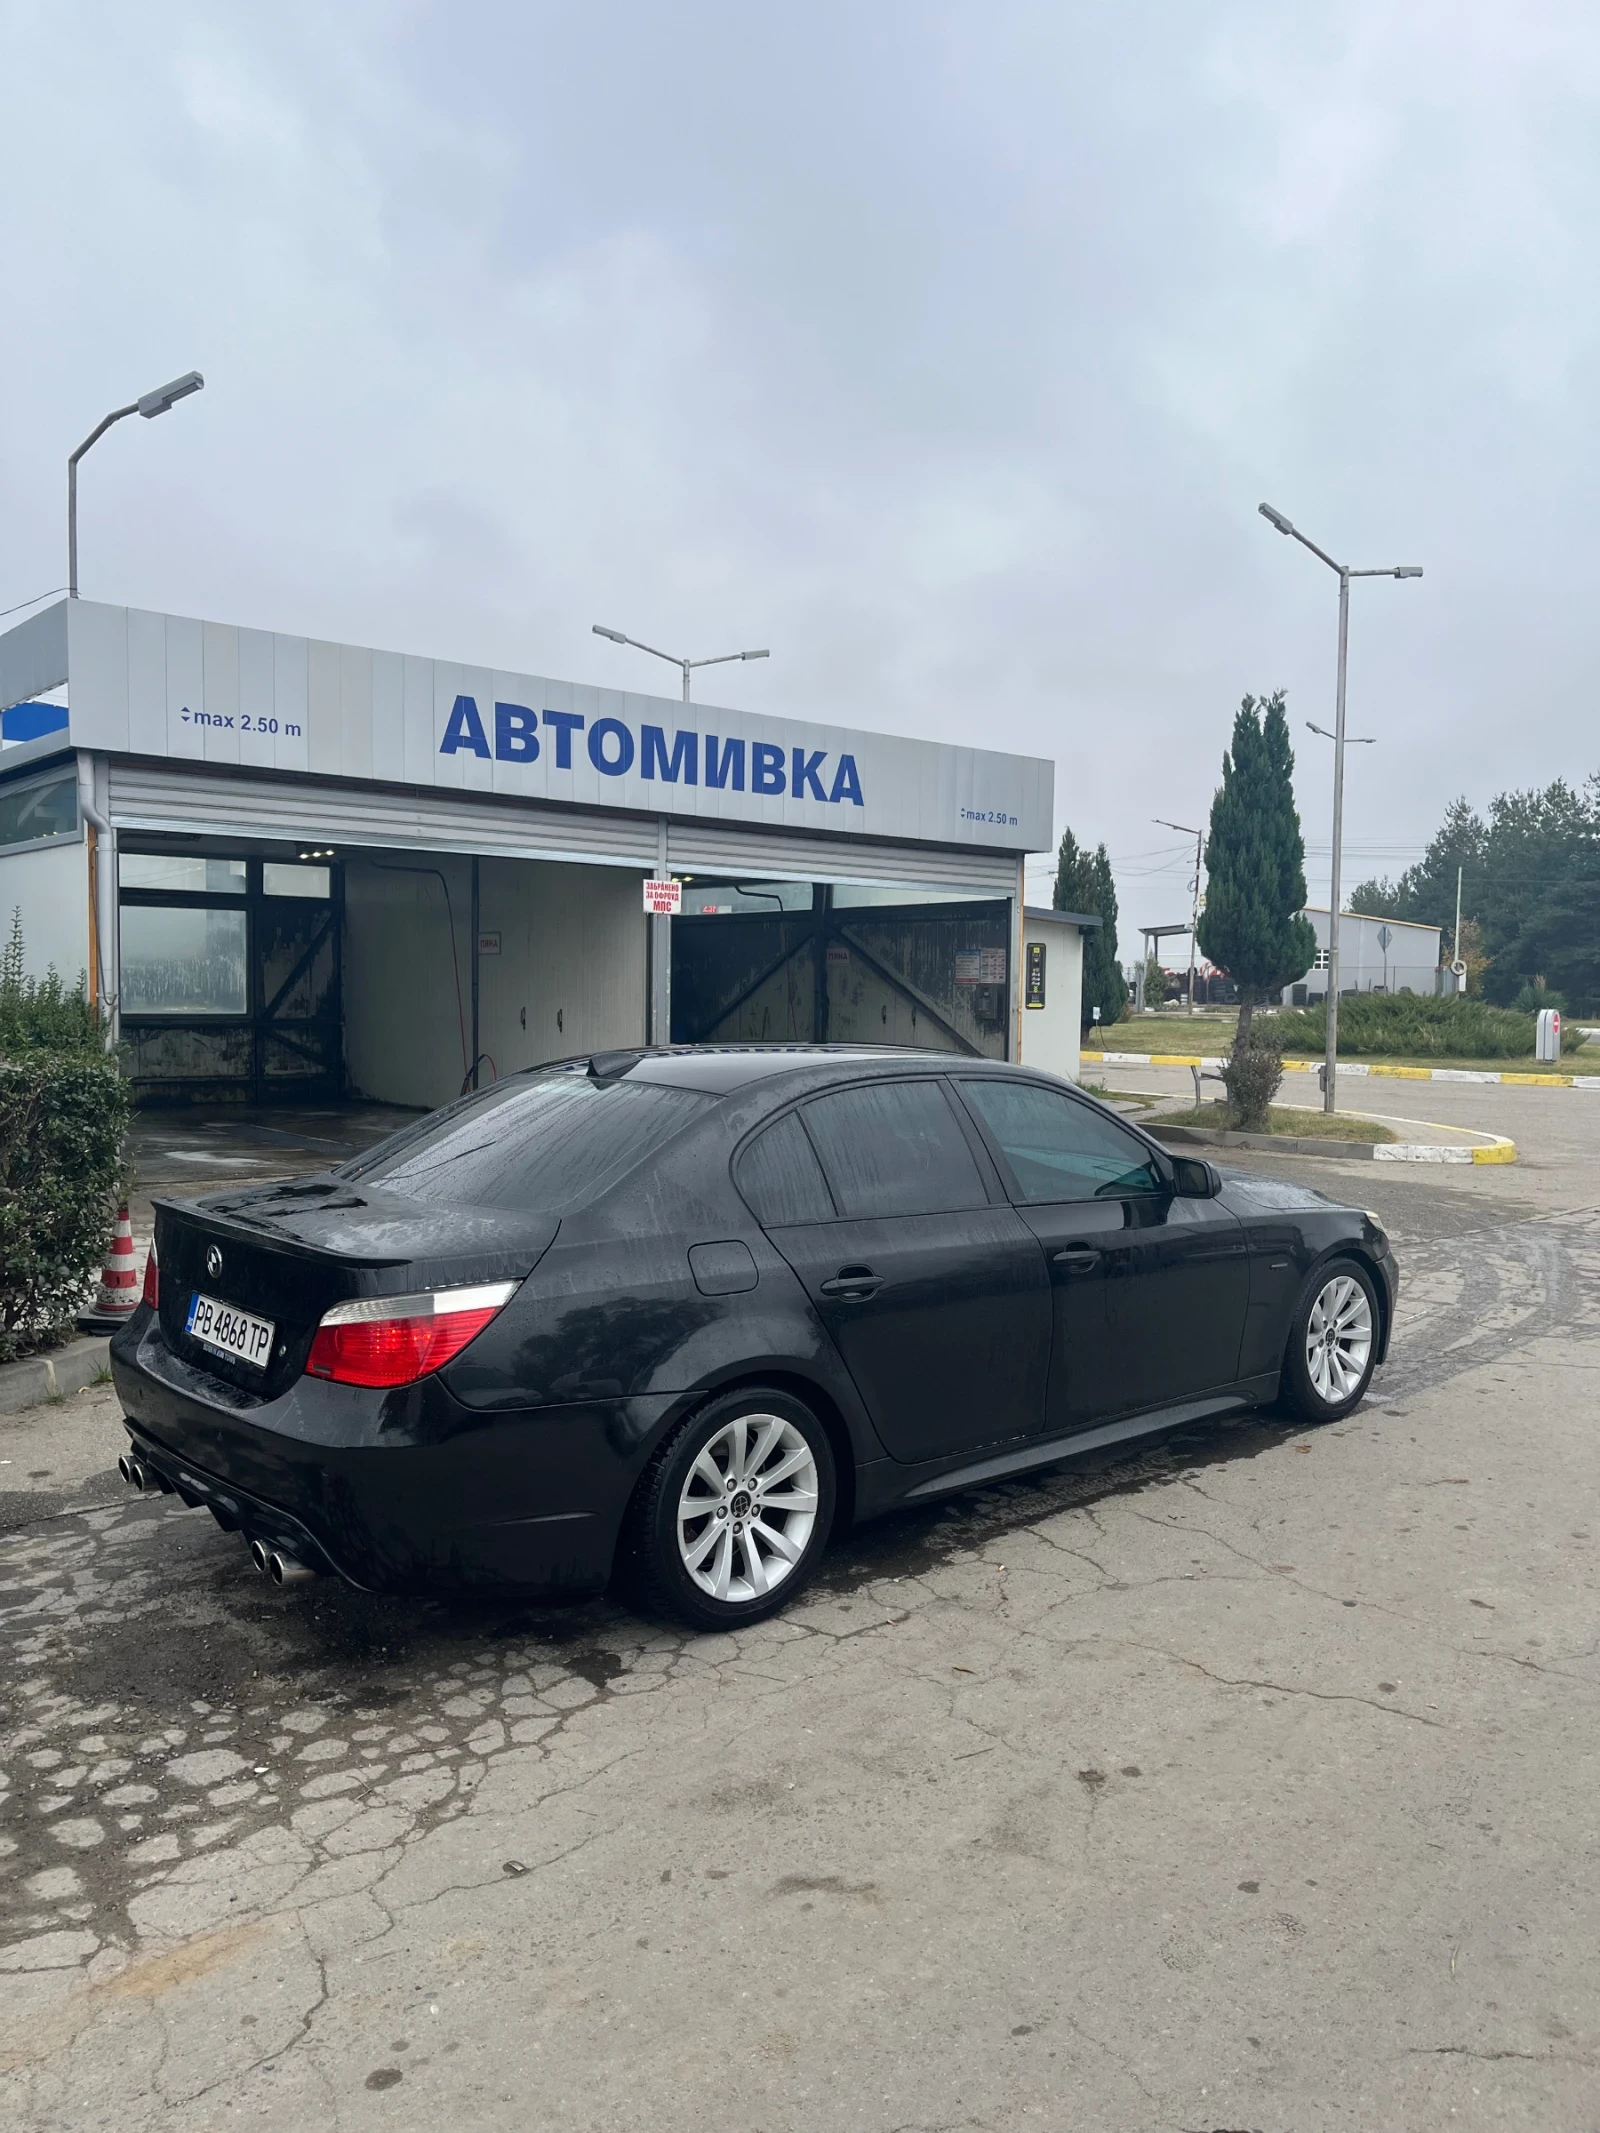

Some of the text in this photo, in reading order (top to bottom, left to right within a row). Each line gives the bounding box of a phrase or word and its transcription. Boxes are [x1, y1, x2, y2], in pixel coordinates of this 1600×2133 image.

[194, 712, 301, 737] max 2.50 m
[439, 694, 865, 807] АВТОМИВКА
[966, 810, 1018, 826] max 2.50 m
[646, 882, 680, 892] ЗАБРАНЕНО
[646, 890, 679, 902] ЗА ОФРОУД
[653, 900, 672, 912] МПС
[213, 1309, 248, 1351] 4868
